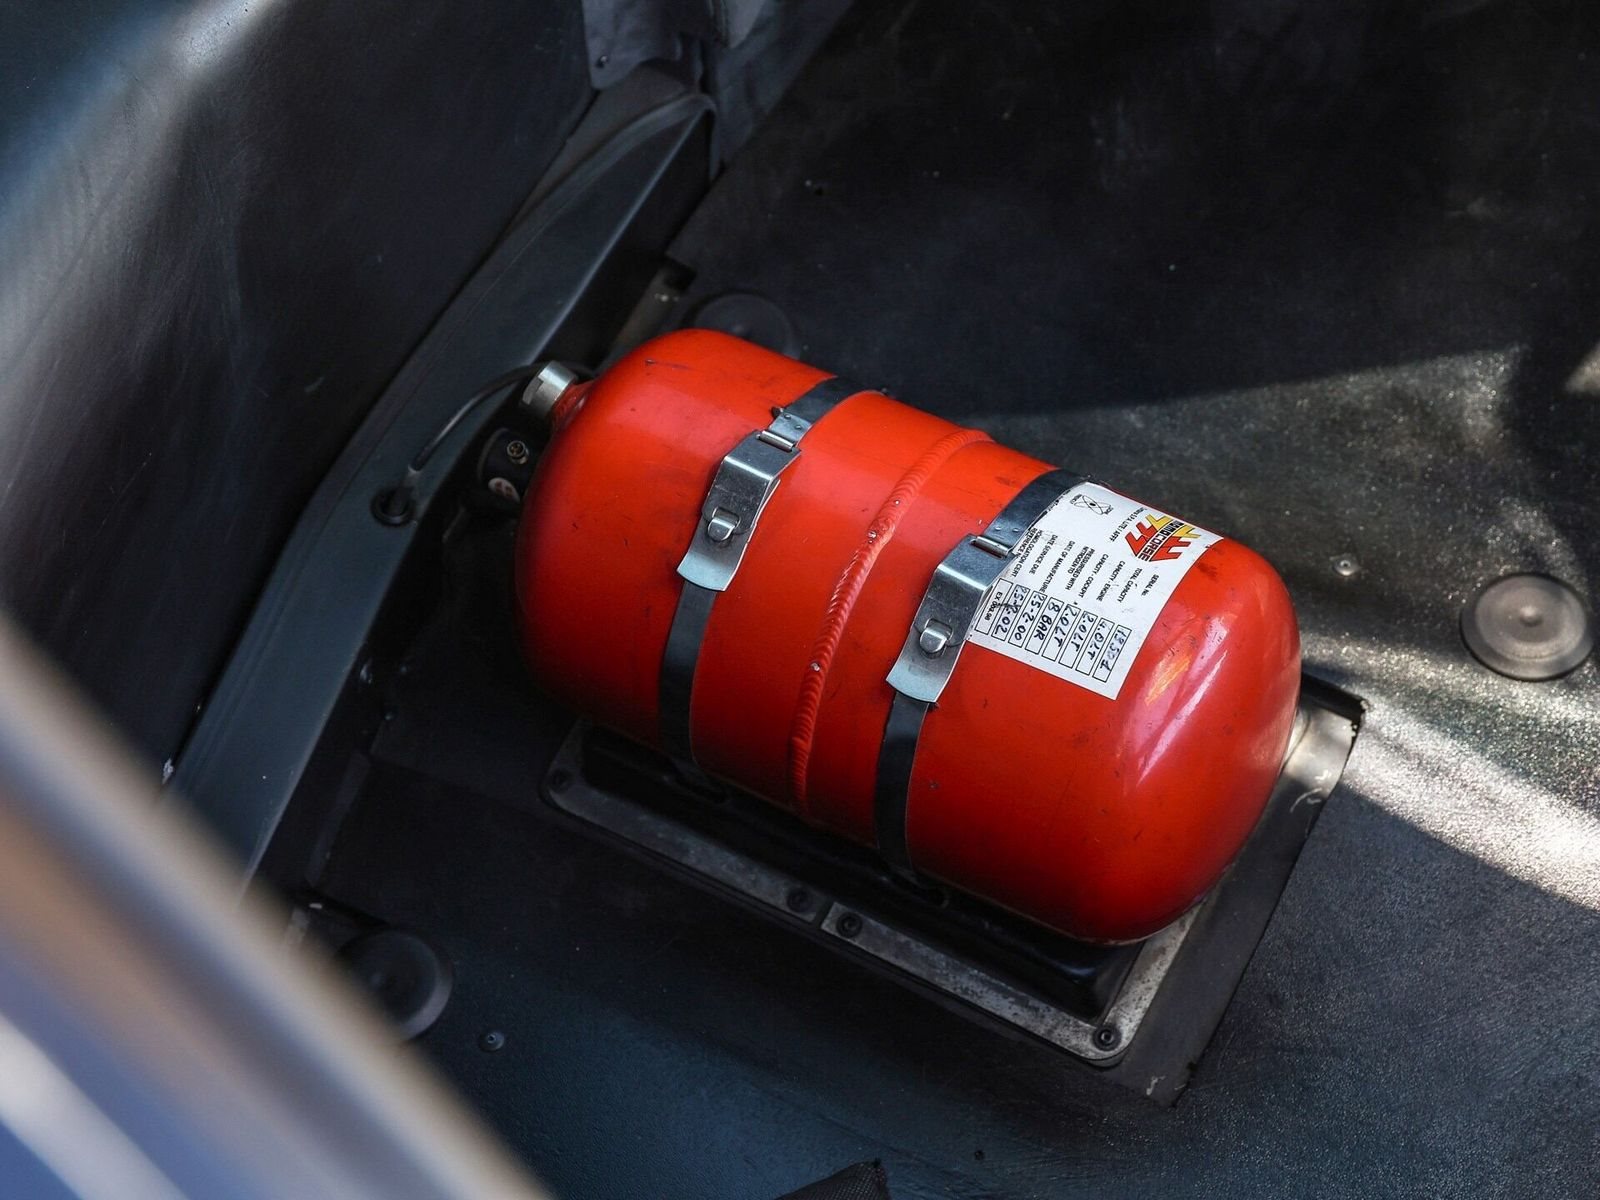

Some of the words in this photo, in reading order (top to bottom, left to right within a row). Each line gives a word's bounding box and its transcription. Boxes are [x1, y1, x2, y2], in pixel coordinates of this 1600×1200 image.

[1018, 527, 1037, 553] REFERENCE
[1019, 529, 1043, 564] HOMOLOGATION
[1047, 534, 1058, 546] DATE
[1064, 541, 1075, 552] DATE
[1035, 545, 1052, 564] SERVICE
[1072, 546, 1088, 568] NITROGEN
[1073, 548, 1095, 578] PRESSURISED
[1093, 554, 1109, 574] CAPACITY
[1029, 564, 1039, 574] DUE
[1039, 557, 1064, 593] MANUFACTURE
[1110, 561, 1125, 581] CAPACITY
[1130, 568, 1142, 579] TOTAL
[1066, 578, 1076, 590] WITH
[1079, 576, 1094, 598] COCKPIT
[1146, 574, 1159, 588] SERIAL
[1096, 583, 1110, 601] ENGINE
[1117, 580, 1134, 603] CAPACITY
[1048, 601, 1061, 613] 8
[1033, 614, 1053, 641] BAR
